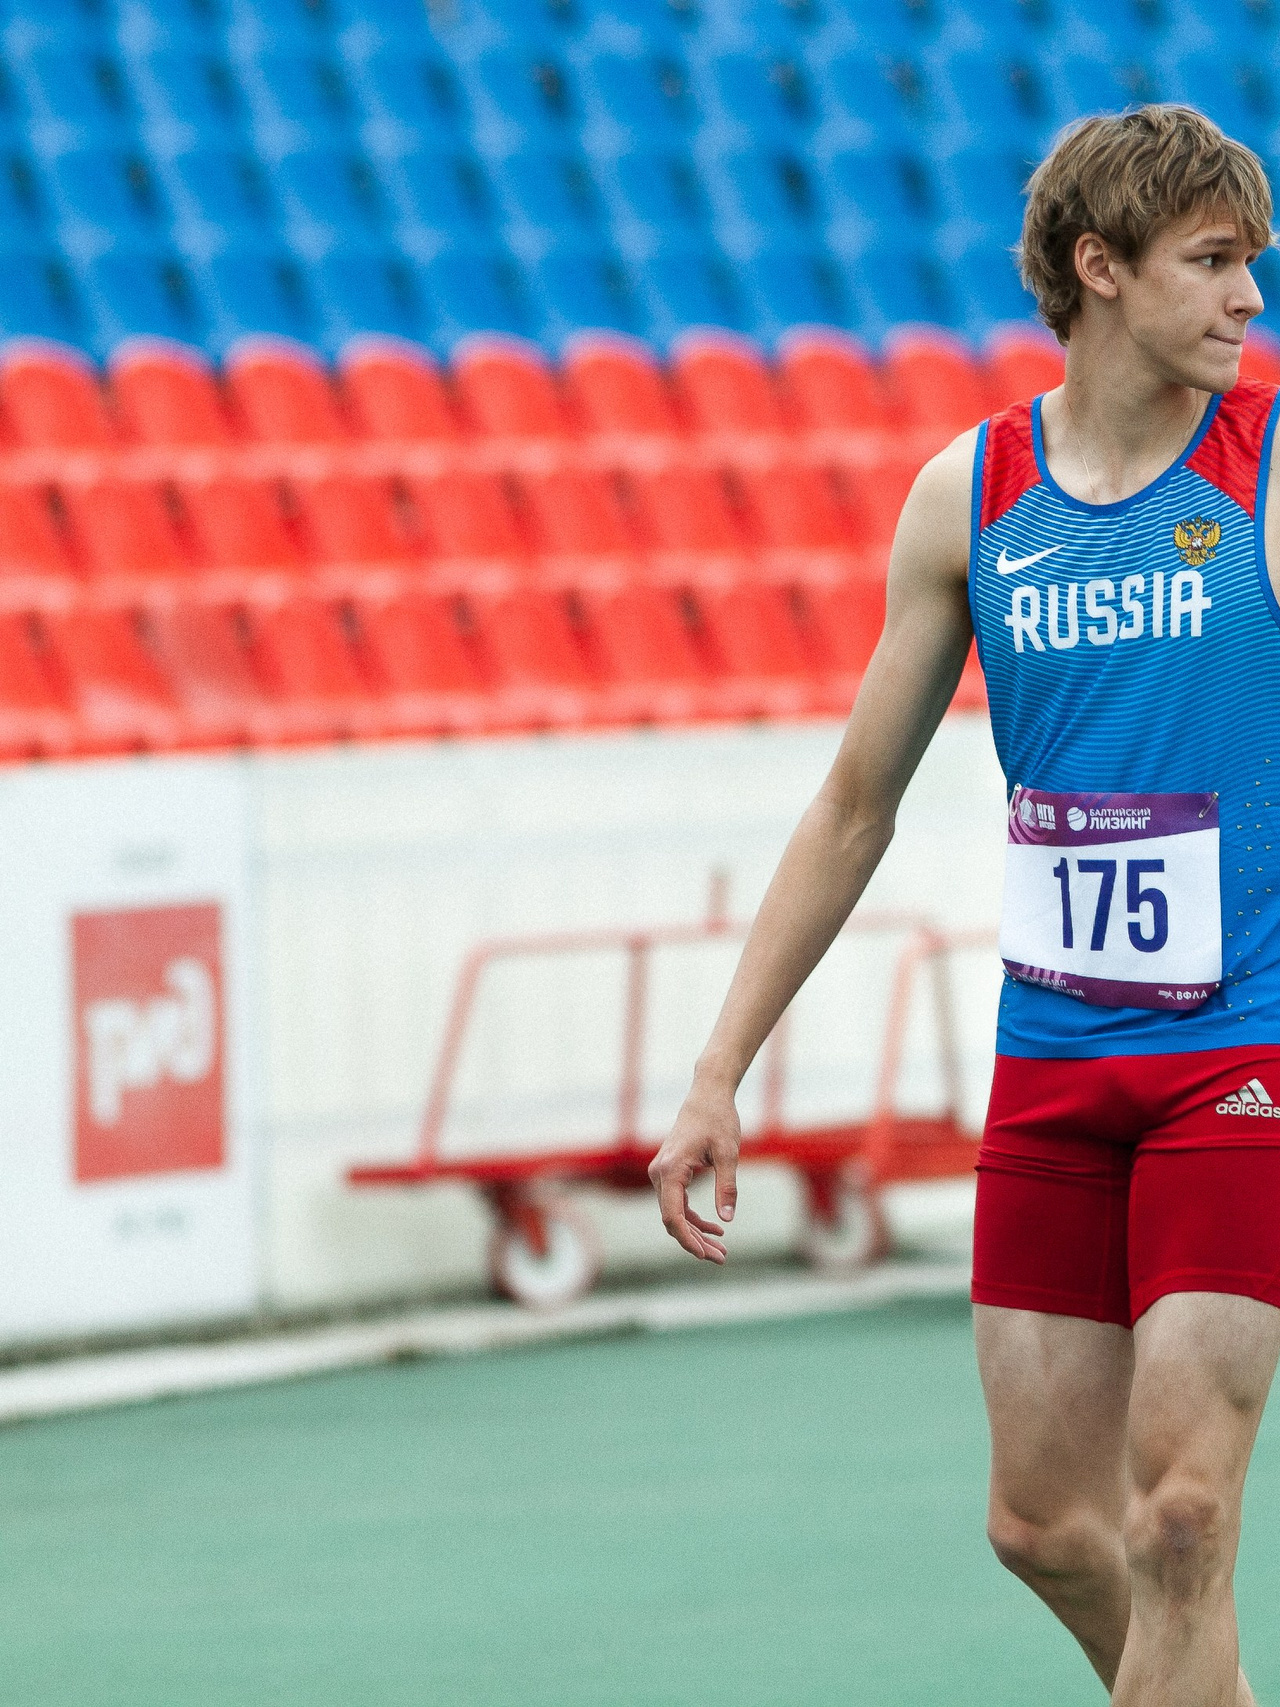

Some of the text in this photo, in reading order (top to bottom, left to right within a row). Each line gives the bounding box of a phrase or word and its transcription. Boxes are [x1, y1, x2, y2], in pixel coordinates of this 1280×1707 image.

[1004, 570, 1212, 653] RUSSIA
[1089, 807, 1151, 817] БАЛТИЙСКИЙ
[1089, 816, 1151, 830] ЛИЗИНГ
[1053, 857, 1169, 953] 175
[1176, 989, 1208, 1001] ВФЛА
